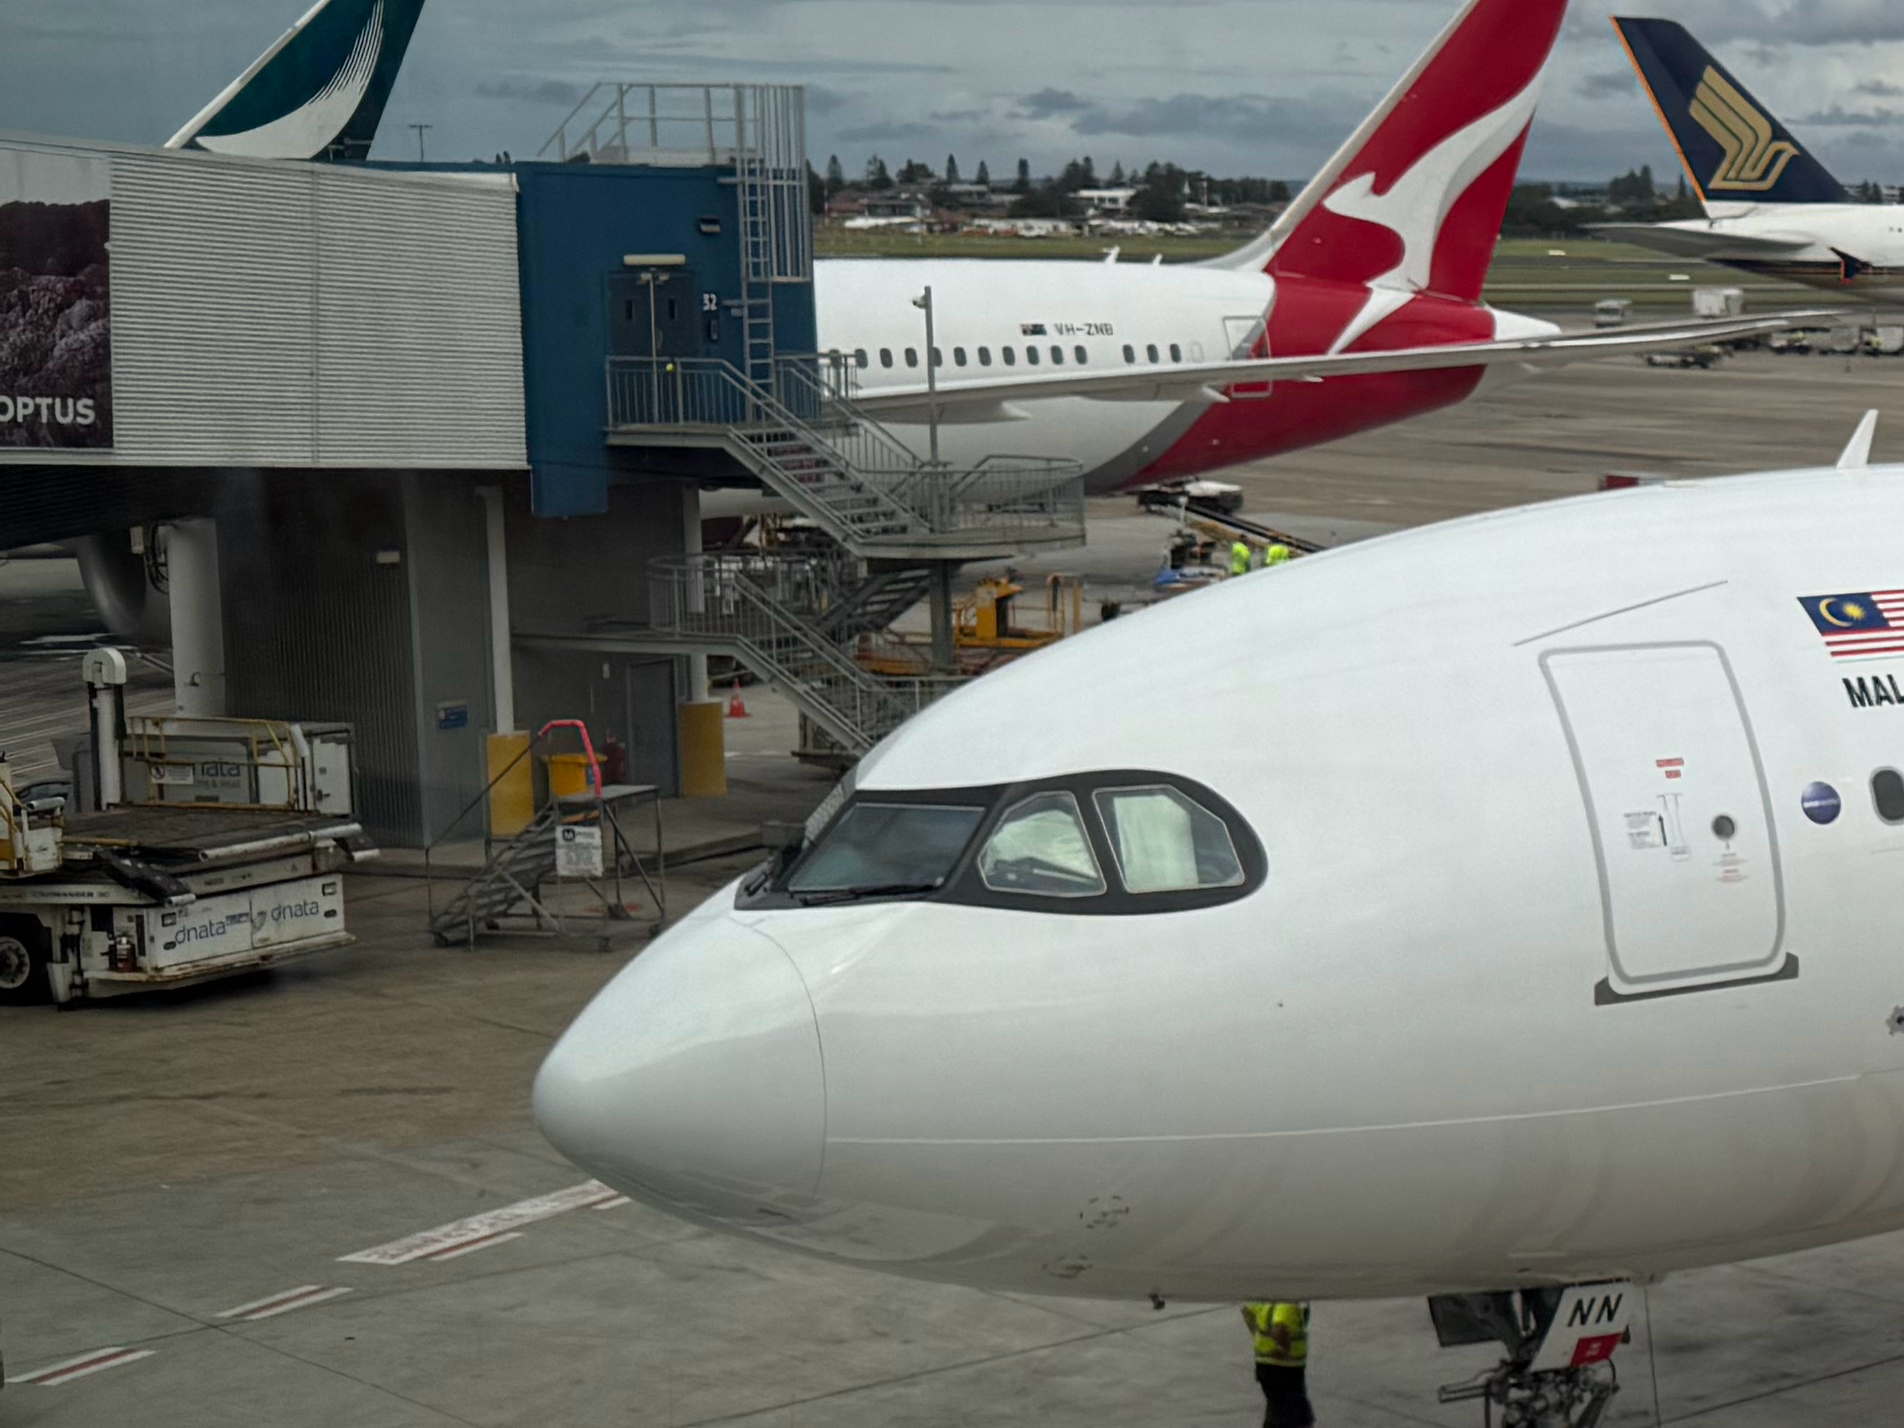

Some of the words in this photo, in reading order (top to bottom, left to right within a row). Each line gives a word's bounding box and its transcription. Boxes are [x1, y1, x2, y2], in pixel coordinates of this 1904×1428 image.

[702, 292, 718, 311] 32
[1054, 322, 1114, 336] VH-ZNB
[270, 899, 320, 922] dnata
[174, 920, 227, 945] dnata
[1567, 1292, 1623, 1328] NN
